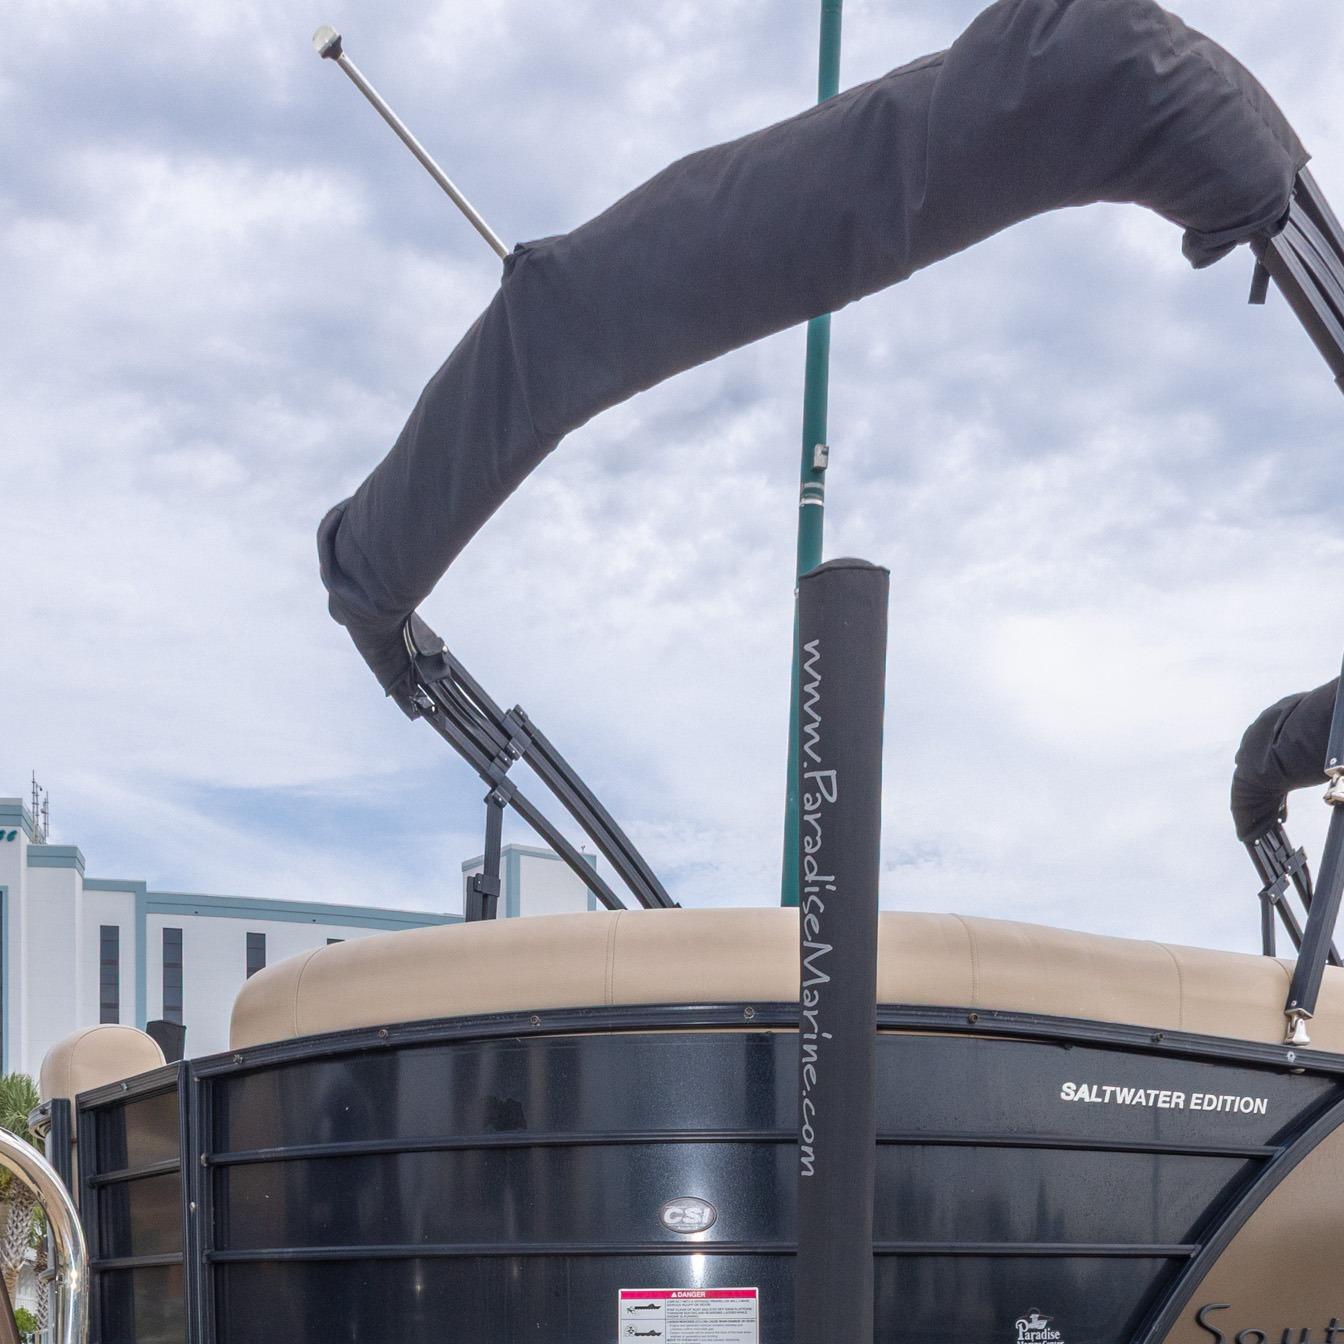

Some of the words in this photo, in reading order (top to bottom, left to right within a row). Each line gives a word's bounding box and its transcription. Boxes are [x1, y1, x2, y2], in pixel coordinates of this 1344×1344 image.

[800, 639, 838, 1177] www.ParadiseMarine.com
[1060, 1082, 1185, 1109] SALTWATER
[1190, 1093, 1268, 1115] EDITION
[663, 1207, 711, 1225] CSI
[1015, 1319, 1060, 1341] Paradise
